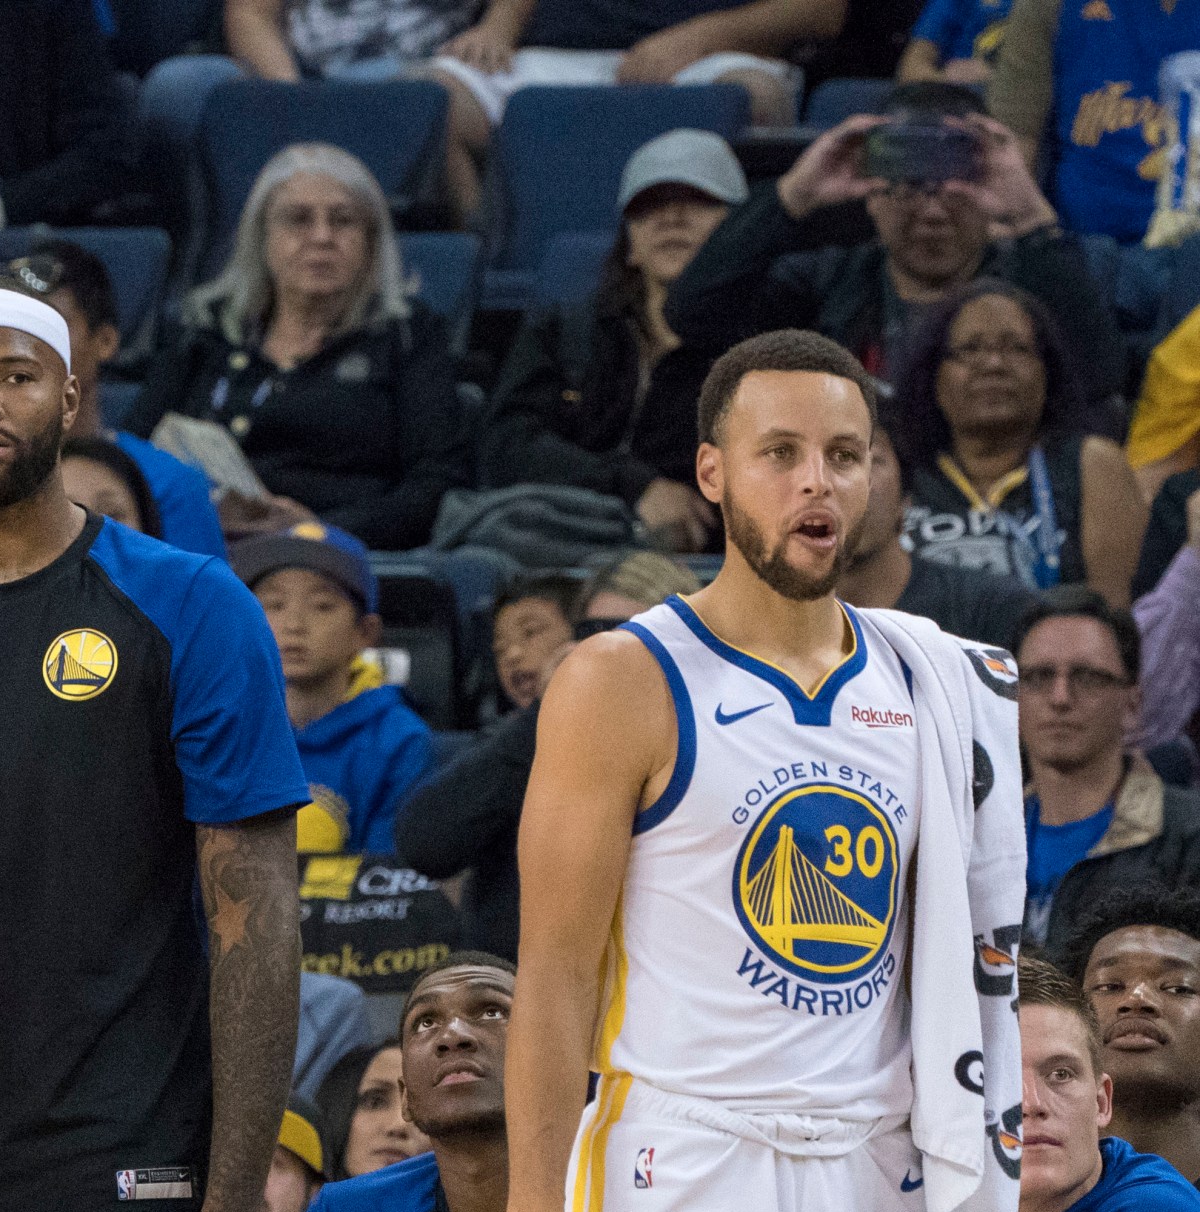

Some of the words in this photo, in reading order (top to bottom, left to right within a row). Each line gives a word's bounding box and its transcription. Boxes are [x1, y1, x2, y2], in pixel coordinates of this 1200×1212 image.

[851, 705, 914, 728] Rakuten
[731, 761, 828, 825] GOLDEN
[838, 765, 909, 825] STATE
[823, 824, 885, 878] 30
[736, 947, 896, 1016] WARRIORS
